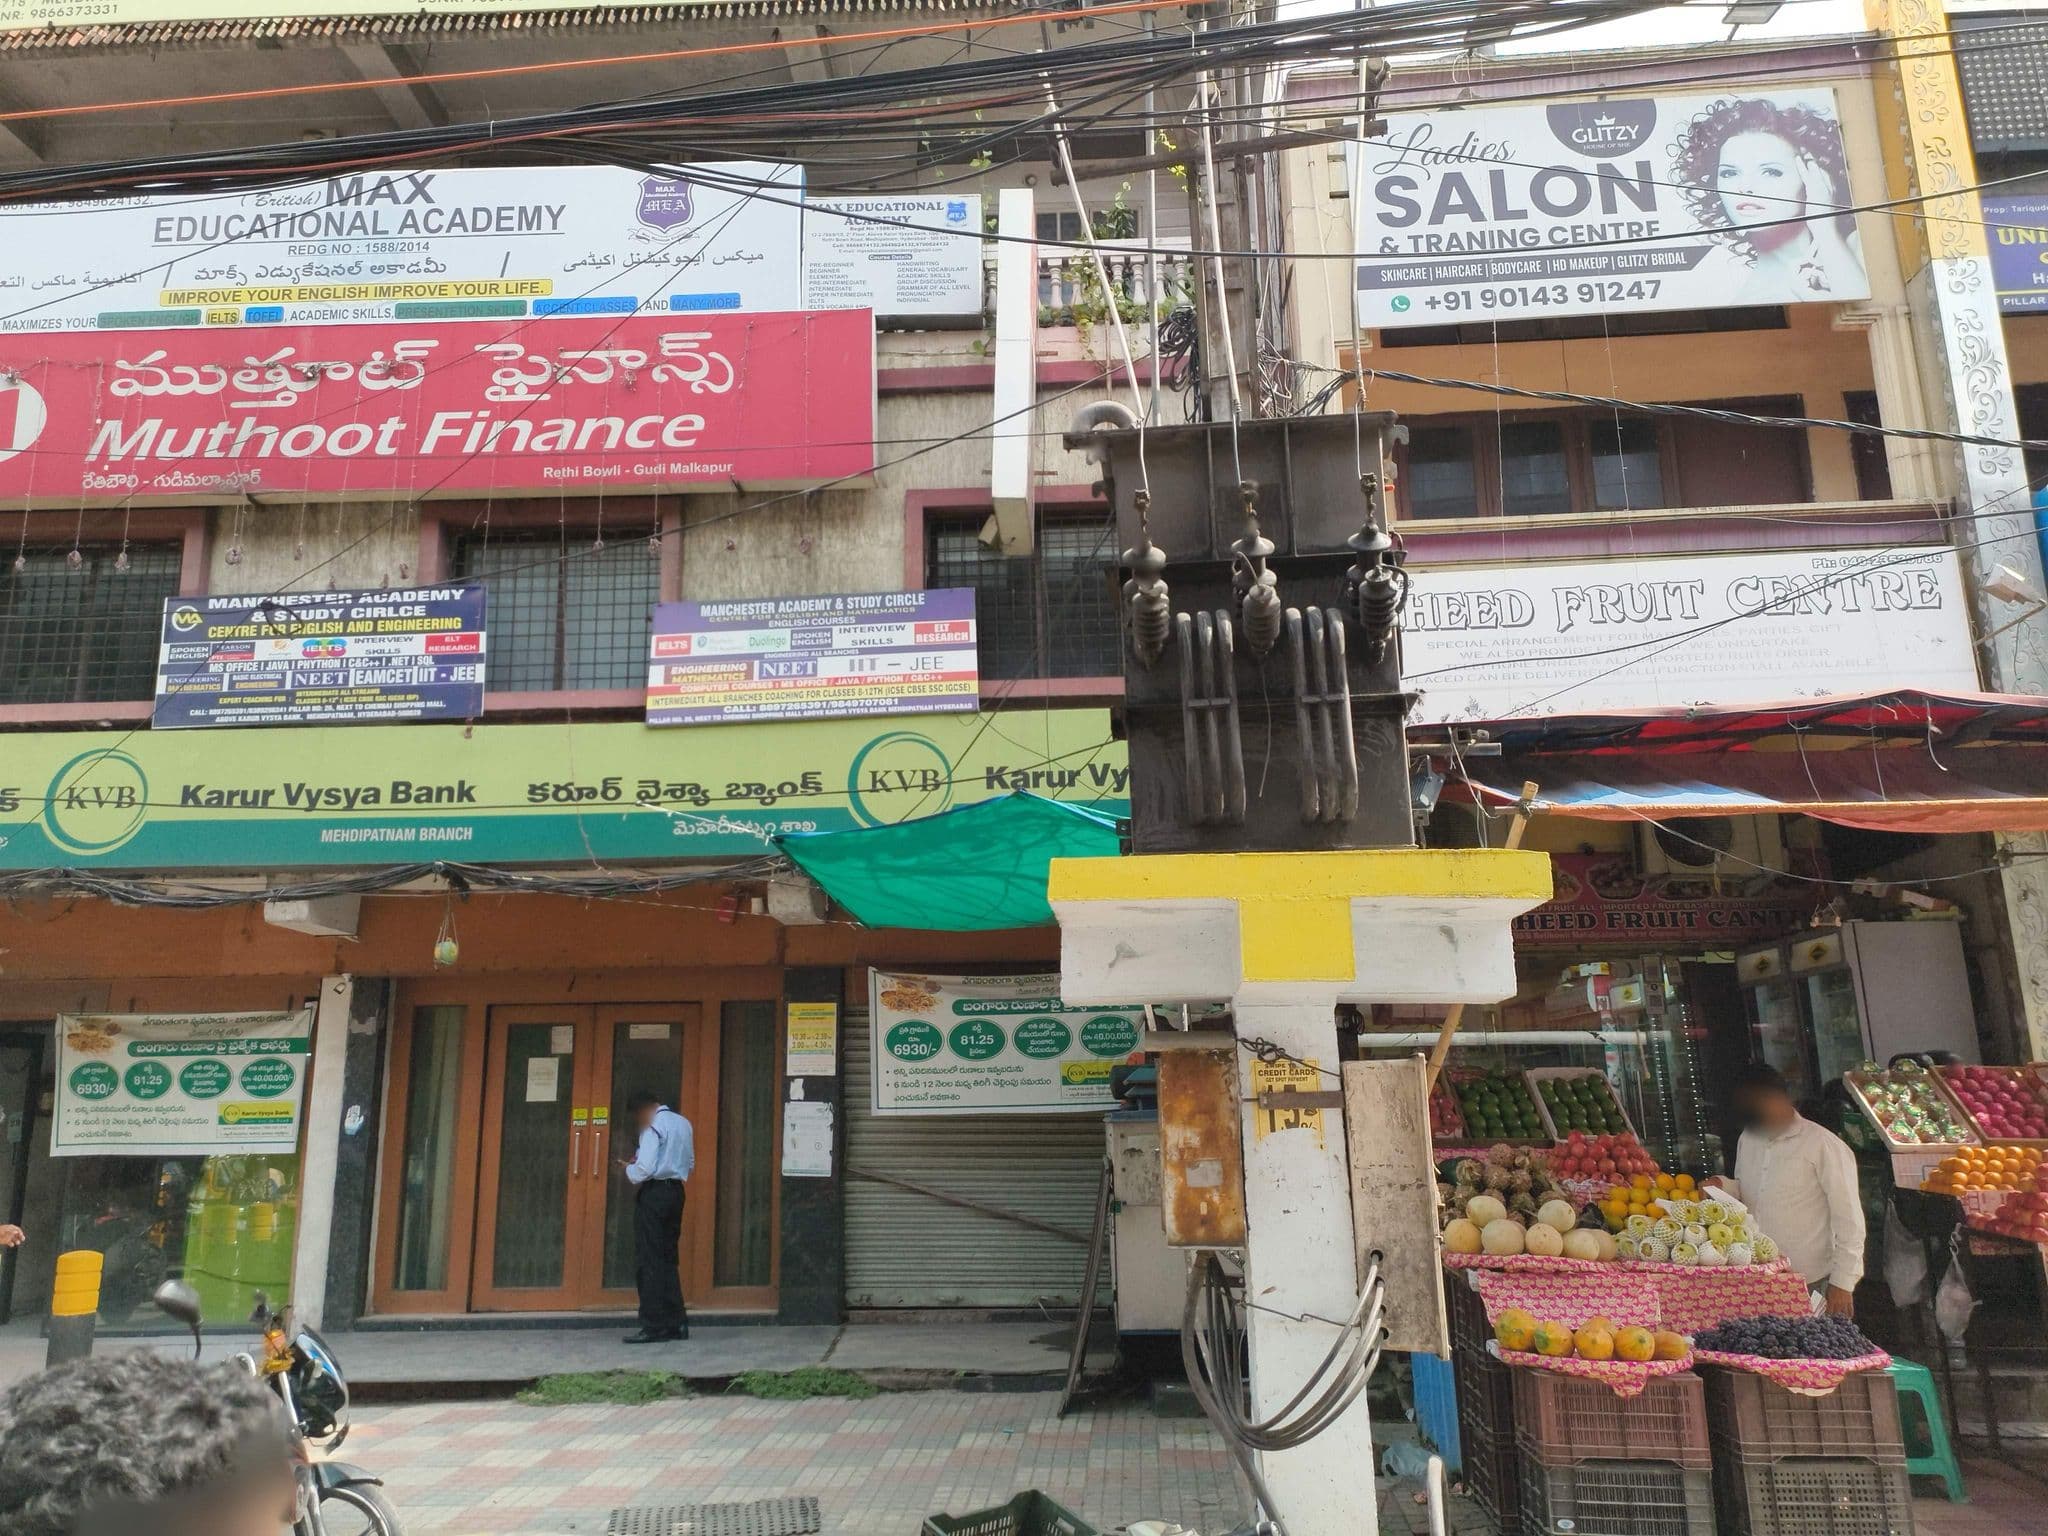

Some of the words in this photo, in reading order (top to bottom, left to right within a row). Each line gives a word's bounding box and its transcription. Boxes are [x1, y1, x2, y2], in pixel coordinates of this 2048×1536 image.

[30, 3, 119, 19] 9866373331
[1571, 124, 1639, 144] GLITZY
[1373, 122, 1517, 181] Ladies
[326, 174, 437, 207] MAX
[655, 185, 676, 193] MAX
[1374, 159, 1659, 229] SALON
[846, 201, 945, 212] EDUCATIONAL
[1983, 206, 2009, 214] Prop:
[153, 209, 389, 243] EDUCATIONAL
[397, 204, 566, 235] ACADEMY
[288, 244, 328, 256] REDG
[331, 243, 352, 254] NO
[365, 241, 430, 253] 1588/2014
[1379, 236, 1400, 254] &
[1407, 227, 1541, 254] TRANING
[194, 264, 248, 286] మాక్స్
[254, 260, 364, 285] ఎడ్యుకేషనల్
[369, 256, 447, 275] అకాడమీ
[1380, 267, 1428, 283] SKINCARE
[1434, 263, 1484, 279] HAIRCARE
[1491, 260, 1542, 276] BODYCARE
[1552, 258, 1567, 272] HD
[1568, 256, 1609, 271] MAKEUP
[1616, 254, 1649, 268] GLITZY
[1650, 251, 1687, 266] BRIDAL
[167, 290, 242, 304] IMPROVE
[247, 288, 293, 302] YOUR
[297, 286, 369, 300] ENGLISH
[373, 284, 449, 299] IMPROVE
[453, 283, 500, 296] YOUR
[505, 282, 544, 294] LIFE.
[1425, 290, 1472, 312] +91
[1479, 284, 1570, 310] 90143
[1576, 279, 1662, 305] 91247
[2002, 296, 2046, 306] PILLAR
[2, 318, 62, 331] MAXIMIZES
[66, 317, 96, 328] YOUR
[290, 309, 350, 321] ACADEMIC
[645, 299, 669, 311] AND
[109, 339, 440, 409] ముత్తూట్
[84, 415, 406, 463] Muthoot
[418, 409, 706, 454] Finance
[543, 465, 579, 479] Rethi
[582, 463, 621, 478] Bowli
[633, 462, 666, 476] Gudi
[669, 461, 734, 478] Malkapur
[1811, 557, 1837, 569] Ph:
[358, 588, 465, 604] ACADEMY
[1551, 578, 1705, 633] FRUIT
[1725, 568, 1942, 618] CENTRE
[700, 602, 776, 618] MANCHESTER
[778, 598, 833, 613] ACADEMY
[835, 597, 844, 610] &
[846, 595, 883, 609] STUDY
[885, 592, 926, 606] CIRCLE
[251, 610, 266, 623] &
[351, 605, 427, 619] CIRLCE
[768, 619, 810, 628] ENGLISH
[811, 616, 856, 626] COURSES
[208, 624, 257, 639] CENTRE
[261, 622, 287, 637] FOR
[290, 620, 343, 637] ENGLISH
[346, 619, 374, 633] AND
[376, 616, 462, 632] ENGINEERING
[792, 631, 832, 639] SPOKEN
[839, 624, 907, 634] INTERVIEW
[934, 623, 950, 632] ELT
[354, 635, 414, 644] INTERVIEW
[444, 635, 462, 643] ELT
[658, 639, 689, 650] IELTS
[749, 635, 786, 649] Duolingo
[792, 638, 832, 647] ENGLISH
[851, 637, 894, 646] SKILLS
[916, 632, 969, 643] RESEARCH
[1426, 638, 1489, 650] SPECIAL
[169, 652, 209, 660] ENGLISH
[170, 646, 209, 654] SPOKEN
[306, 644, 343, 653] IELTS
[428, 644, 476, 653] RESEARCH
[209, 663, 224, 673] MS
[225, 662, 258, 672] OFFICE
[266, 661, 290, 670] JAVA
[297, 658, 341, 670] PHYTHON
[670, 662, 748, 675] ENGINEERING
[761, 660, 818, 678] NEET
[849, 657, 880, 672] IIT
[909, 656, 944, 671] JEE
[294, 671, 349, 687] NEET
[355, 668, 413, 685] EAMCET
[419, 667, 437, 682] IIT
[450, 666, 475, 681] JEE
[671, 672, 746, 683] MATHEMATICS
[679, 684, 730, 693] COMPUTER
[835, 677, 861, 685] JAVA
[867, 675, 904, 684] PYTHON
[708, 694, 721, 703] ALL
[723, 691, 763, 703] BRANCHES
[765, 690, 805, 701] COACHING
[806, 690, 821, 699] FOR
[822, 688, 856, 698] CLASSES
[906, 685, 927, 694] CBSE
[928, 684, 944, 693] SSC
[723, 704, 757, 714] CALL:
[868, 767, 941, 794] KVB
[985, 764, 1082, 791] Karur
[65, 785, 137, 810] KVB
[180, 784, 275, 809] Karur
[283, 780, 383, 813] Vysya
[390, 778, 477, 805] Bank
[527, 776, 623, 804] కరూర్
[725, 771, 824, 807] బ్యాంక్
[320, 827, 416, 844] MEHDIPATNAM
[418, 825, 473, 842] BRANCH
[1605, 910, 1699, 931] FRUIT
[960, 1034, 995, 1046] 81.25
[893, 1042, 938, 1057] 6930/-
[133, 1074, 163, 1086] 81.25
[1257, 1068, 1287, 1077] CREDIT
[1288, 1067, 1317, 1077] CARDS
[76, 1082, 115, 1096] 6930/-
